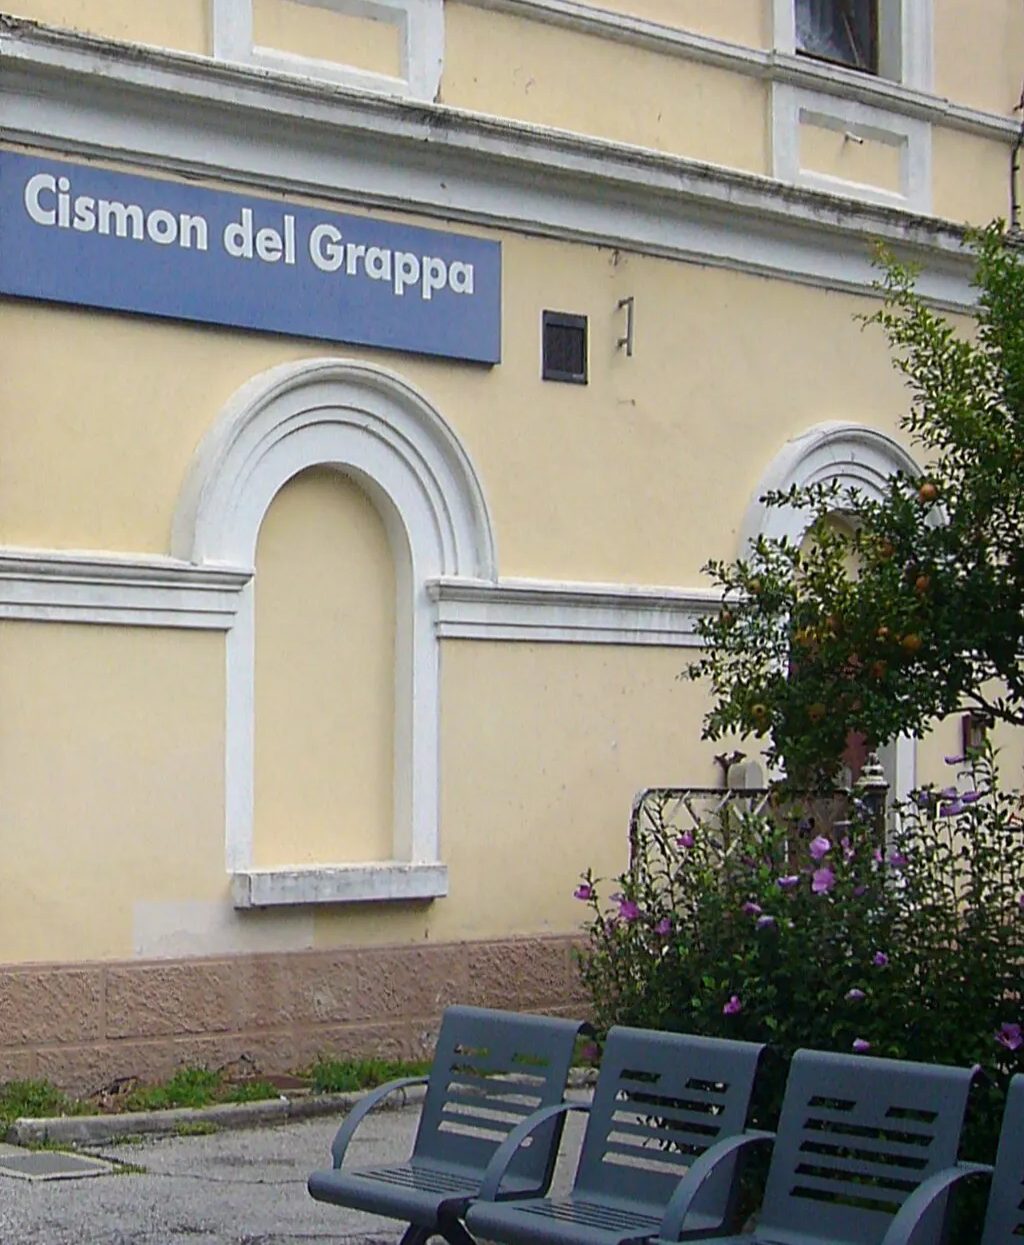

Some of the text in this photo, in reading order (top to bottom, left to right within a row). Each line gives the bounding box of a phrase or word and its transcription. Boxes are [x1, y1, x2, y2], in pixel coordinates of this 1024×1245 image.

[24, 173, 475, 299] Cismon del Grappa
